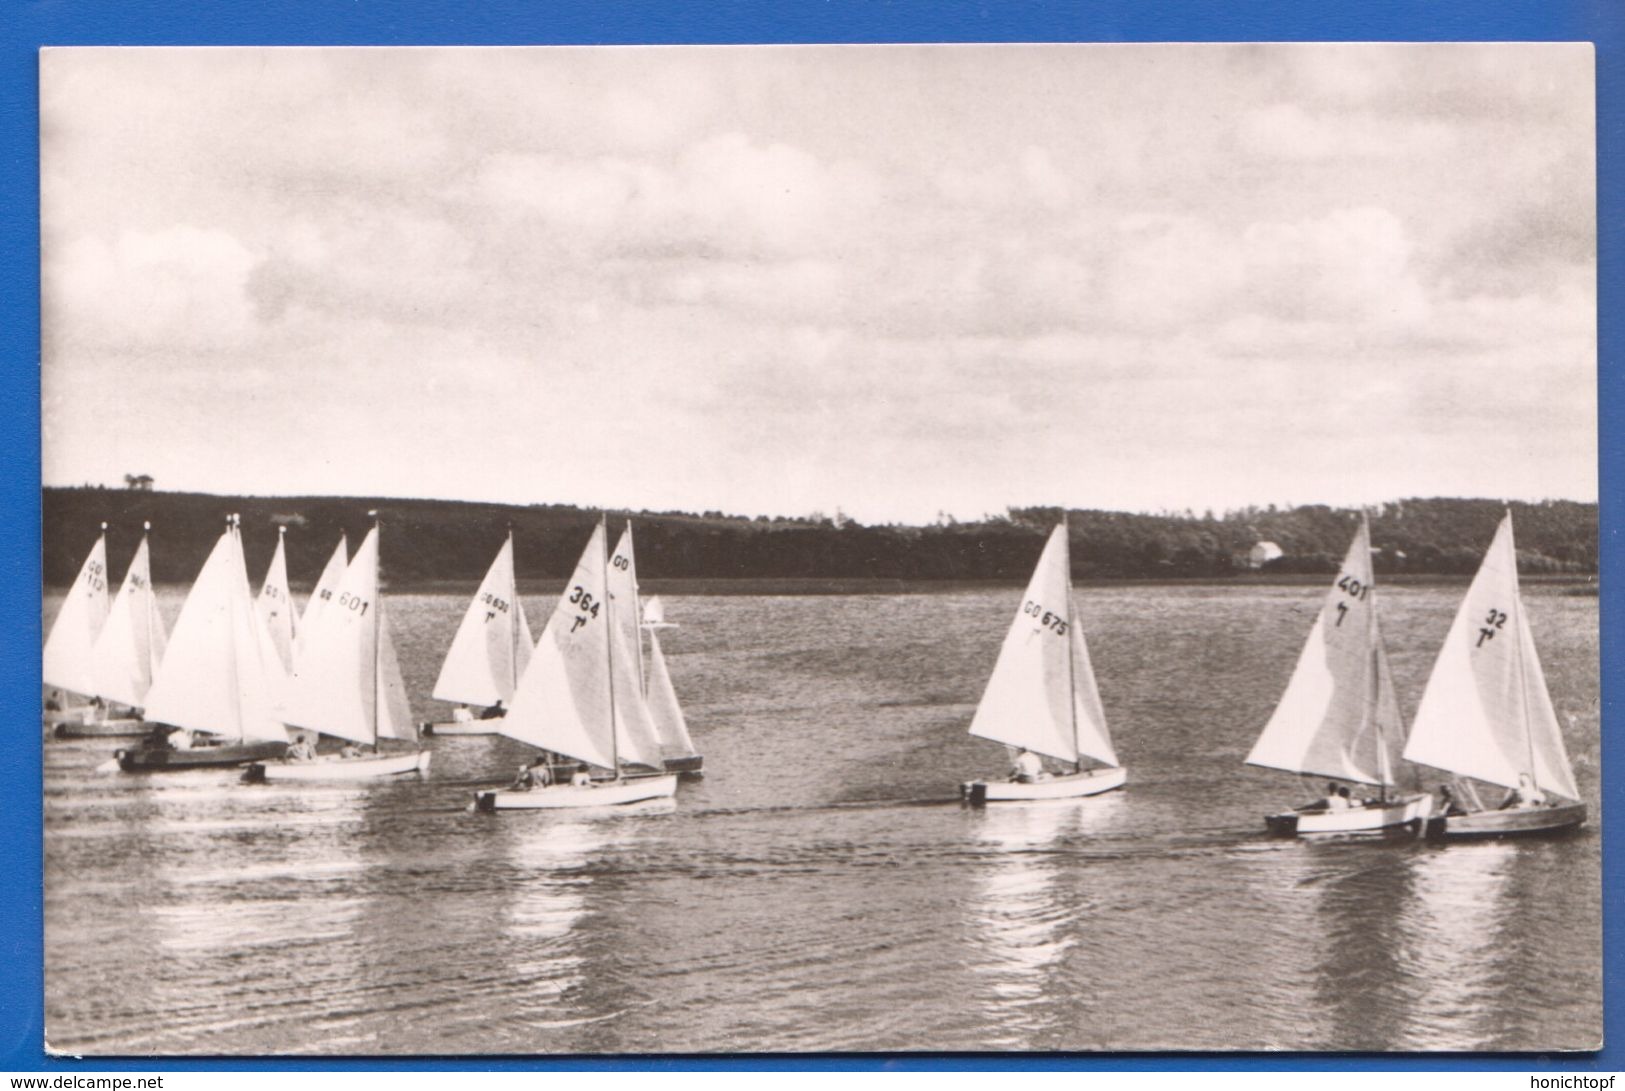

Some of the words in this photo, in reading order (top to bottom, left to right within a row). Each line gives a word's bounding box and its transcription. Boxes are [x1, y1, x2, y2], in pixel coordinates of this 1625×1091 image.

[613, 554, 629, 571] GO
[1338, 575, 1368, 601] 401
[338, 591, 369, 616] 601
[569, 585, 601, 619] 364
[1023, 600, 1042, 618] GO
[1042, 611, 1069, 636] 675
[1485, 608, 1508, 629] 32
